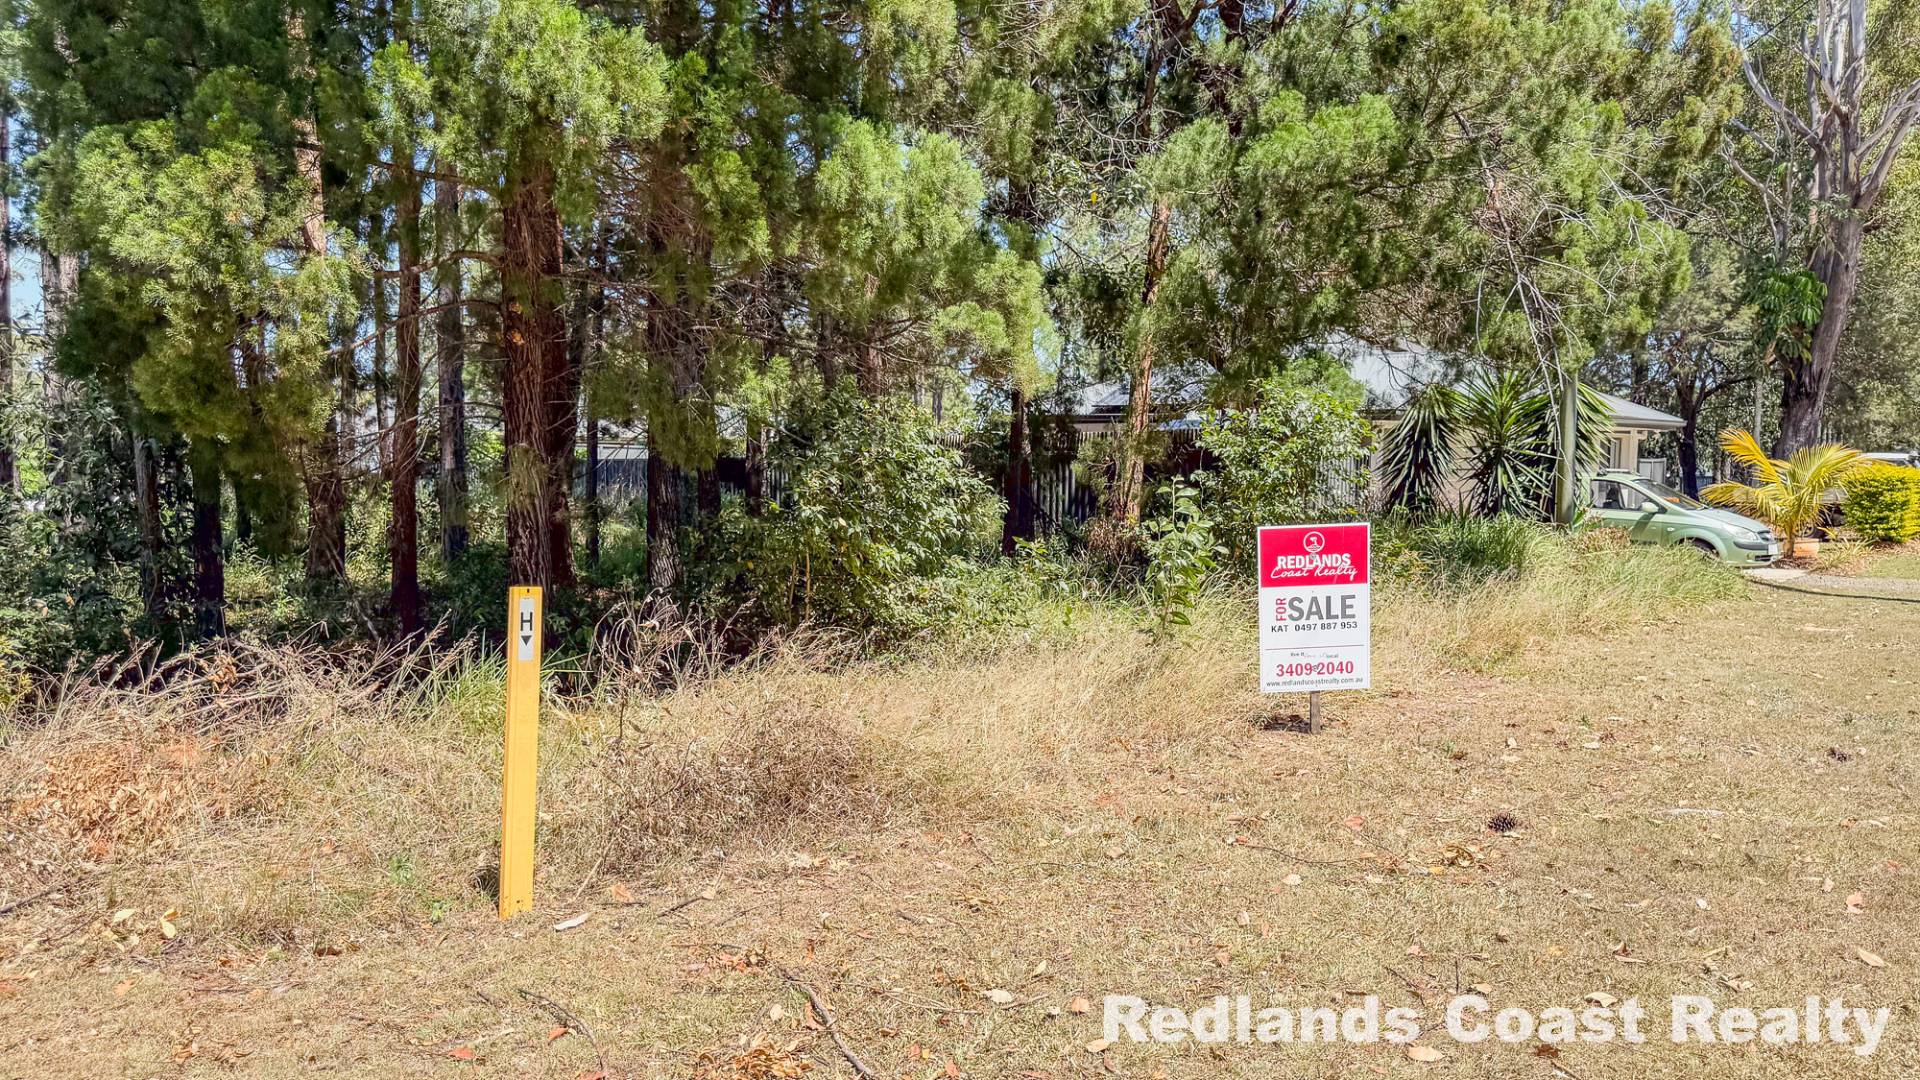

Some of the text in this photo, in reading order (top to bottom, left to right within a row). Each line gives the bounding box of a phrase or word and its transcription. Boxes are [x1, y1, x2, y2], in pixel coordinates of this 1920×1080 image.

[1277, 553, 1352, 569] REDLANDS
[1271, 564, 1358, 581] Coast Realty
[1276, 595, 1356, 621] FOR SALE
[520, 611, 533, 631] H
[1271, 621, 1358, 633] KAT 0497 887 953
[1276, 660, 1354, 677] 3409 2040
